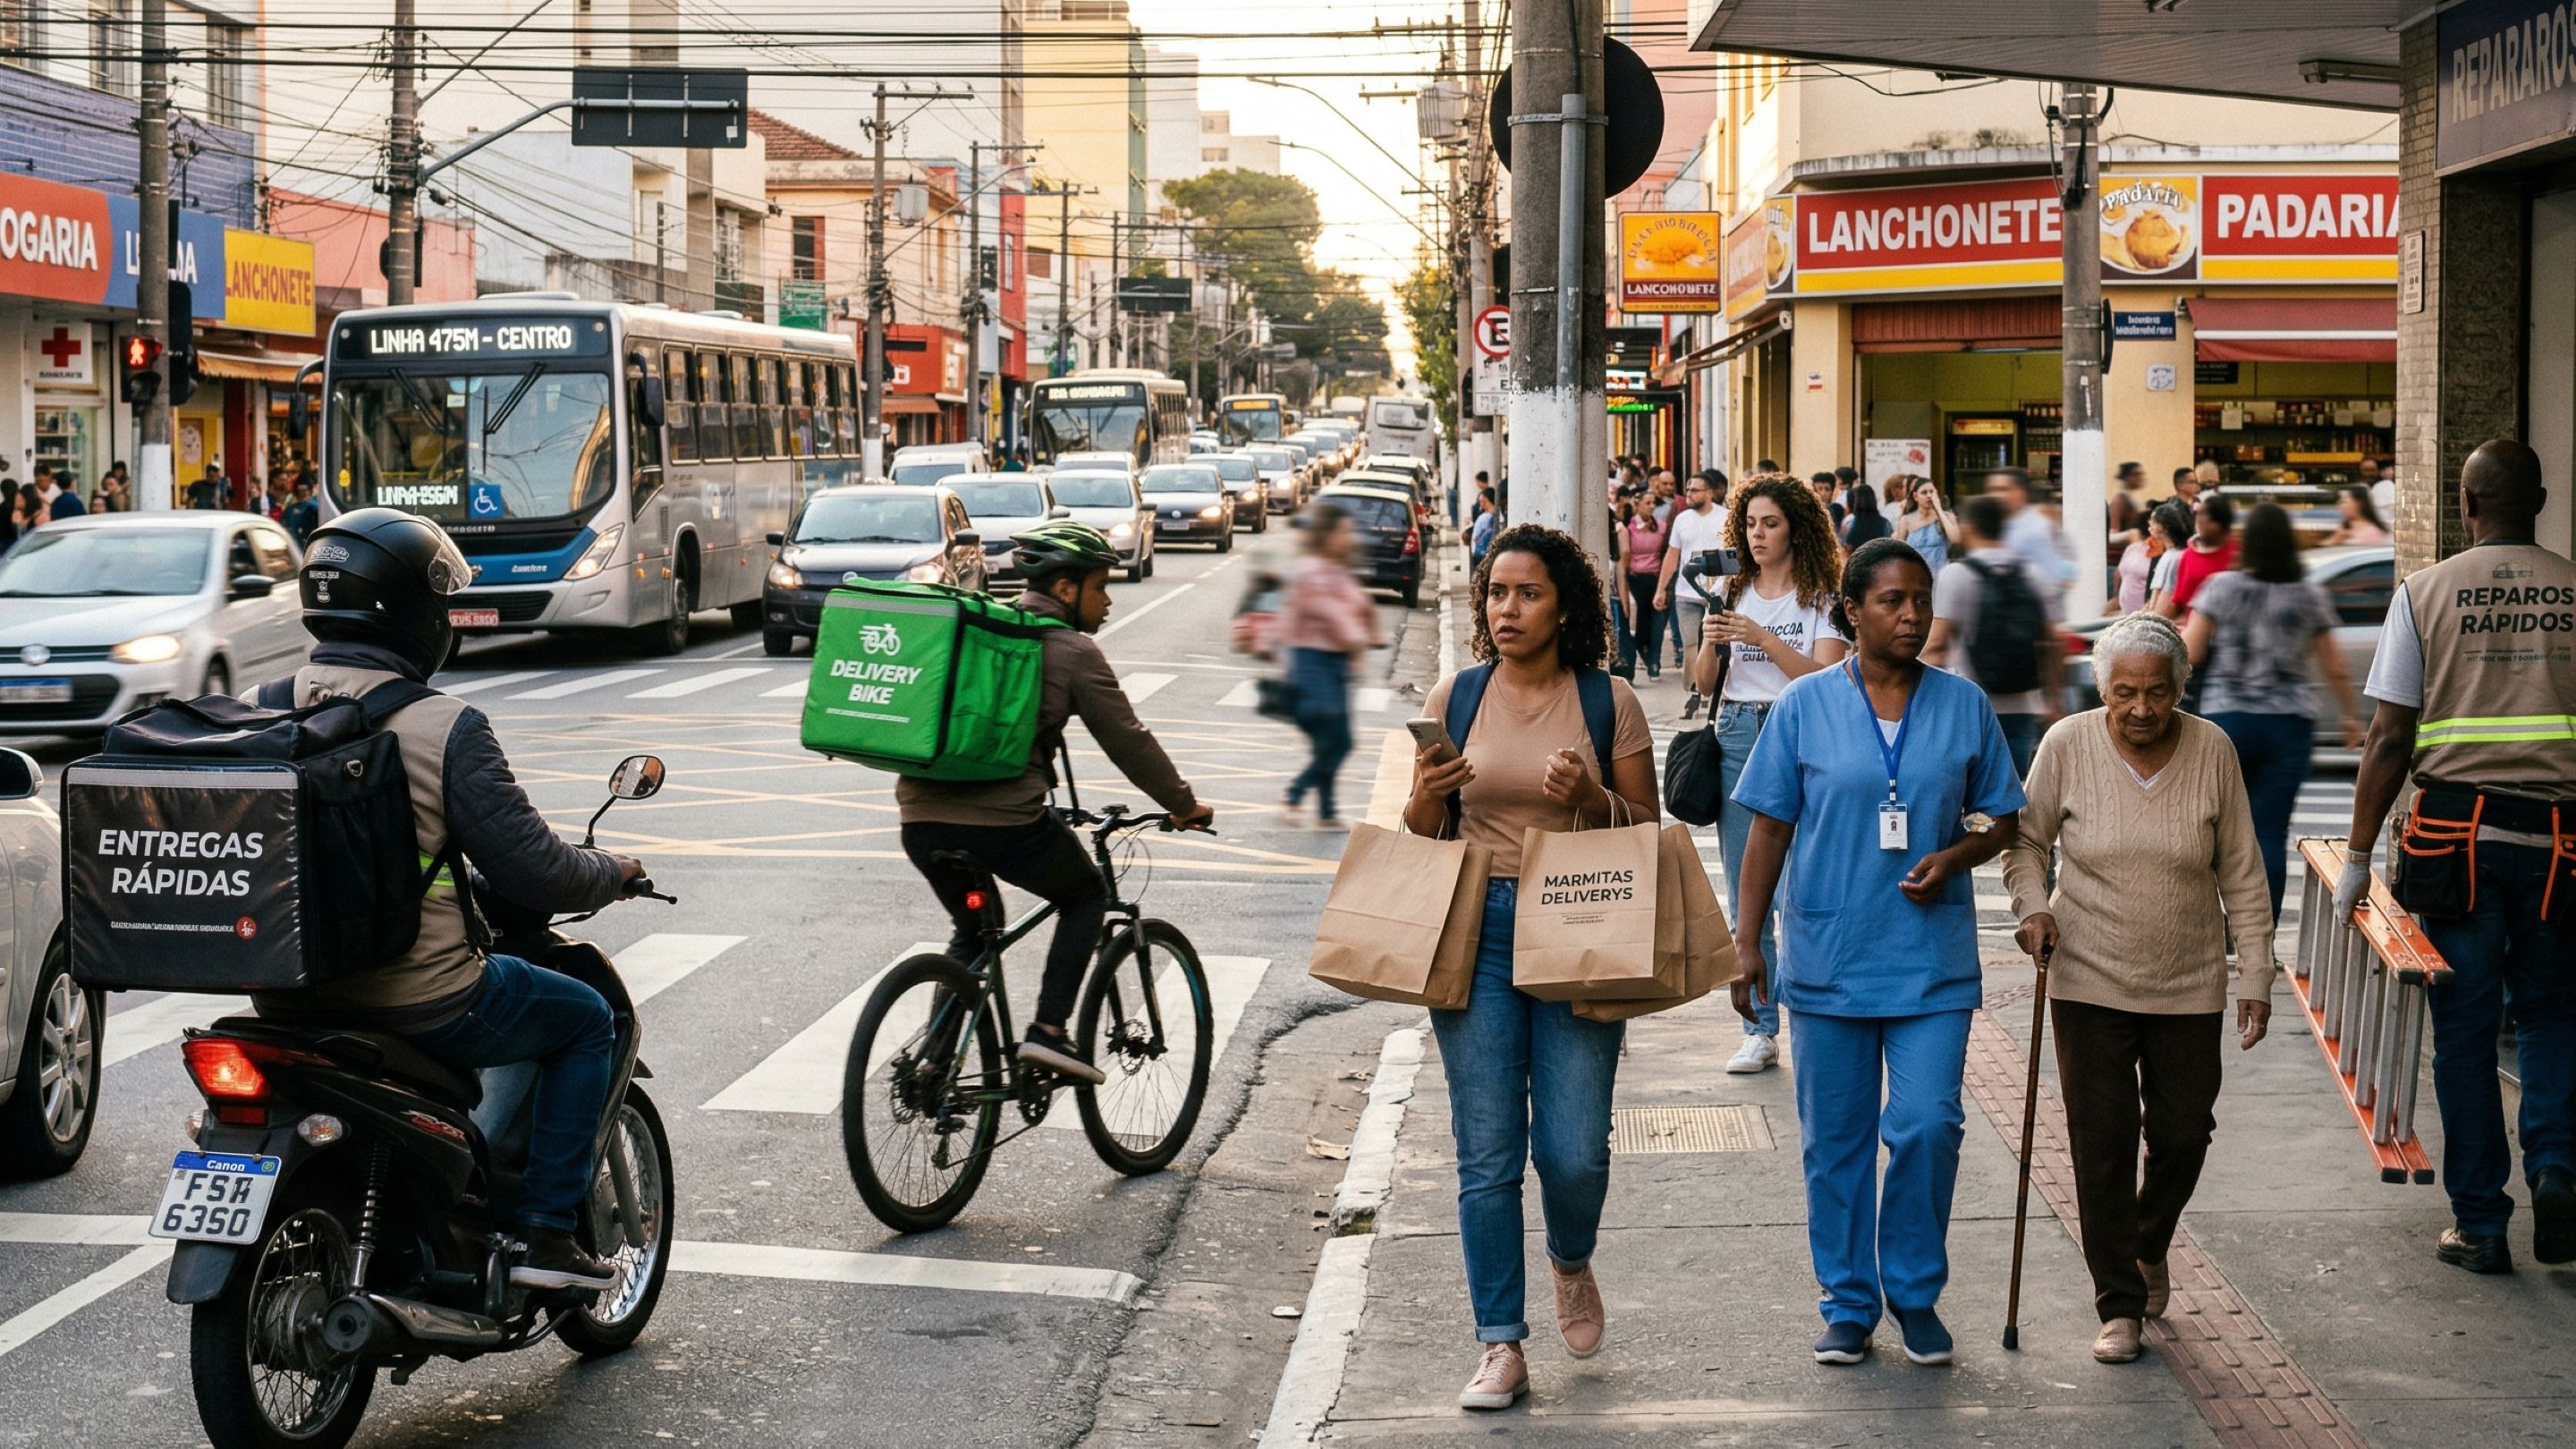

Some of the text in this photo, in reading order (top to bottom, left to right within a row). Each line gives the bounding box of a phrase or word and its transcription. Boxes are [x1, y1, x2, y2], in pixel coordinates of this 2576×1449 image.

[1809, 197, 2062, 253] LANCHONETE
[0, 207, 98, 271] OGARIA
[370, 328, 426, 353] LINHA
[428, 327, 479, 352] 475M
[497, 326, 572, 350] CENTRO
[2456, 586, 2574, 607] REPAROS
[2461, 608, 2574, 634] RÁPIDOS
[830, 659, 923, 685] DELIVERY
[848, 683, 894, 705] BIKE
[97, 829, 264, 859] ENTREGAS
[111, 861, 250, 896] RÁPIDAS
[1544, 869, 1633, 888] MARMITAS
[1541, 887, 1633, 905] DELIVERYS
[207, 1159, 245, 1172] Canon
